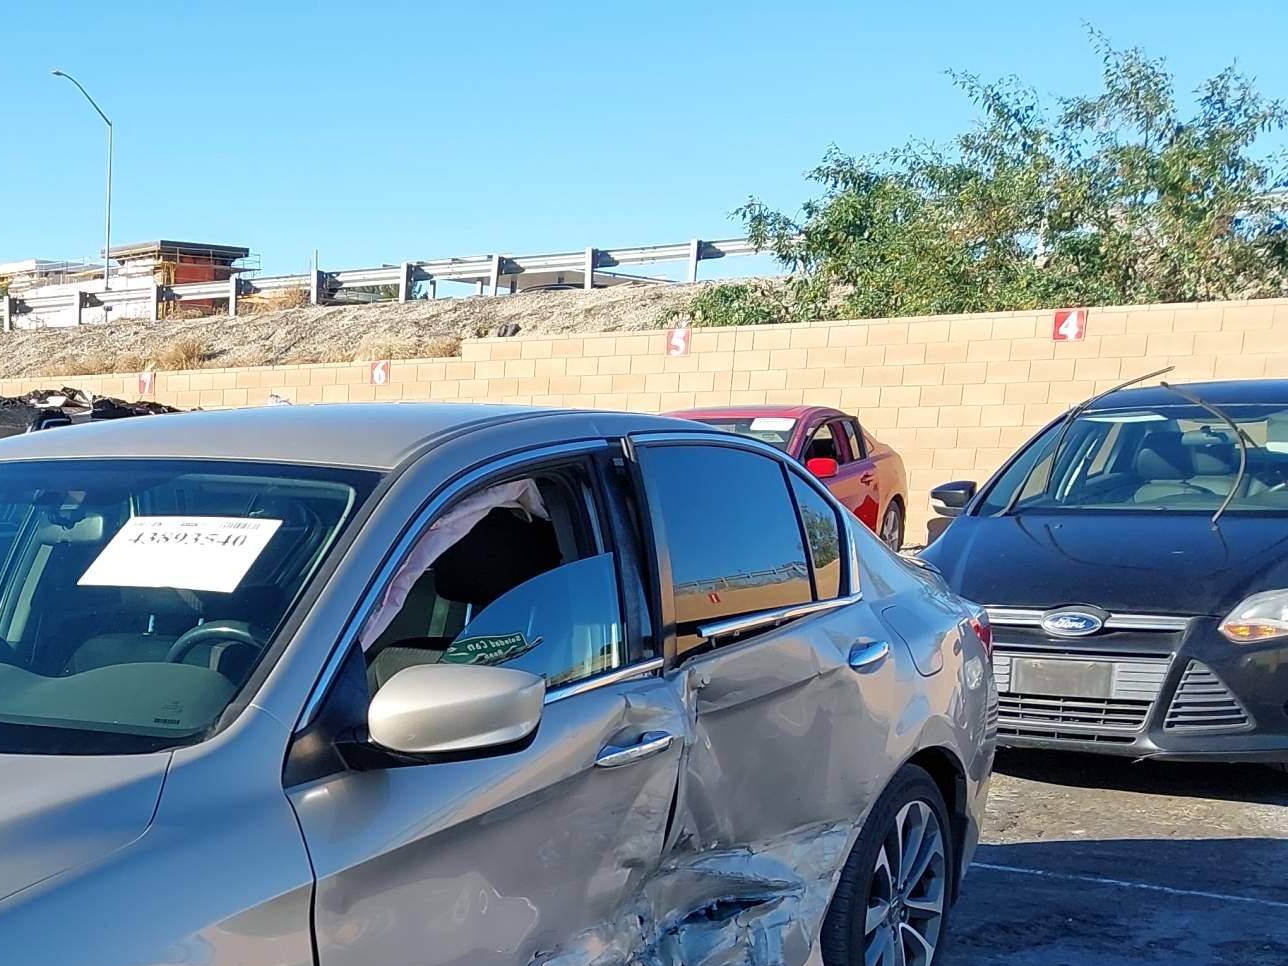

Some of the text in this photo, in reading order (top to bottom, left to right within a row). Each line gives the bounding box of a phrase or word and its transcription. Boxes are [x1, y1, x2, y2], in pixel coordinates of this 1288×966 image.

[1058, 310, 1080, 341] 4
[670, 329, 686, 356] 5
[141, 371, 153, 393] 7
[373, 361, 386, 385] 6
[128, 532, 248, 547] 43893540
